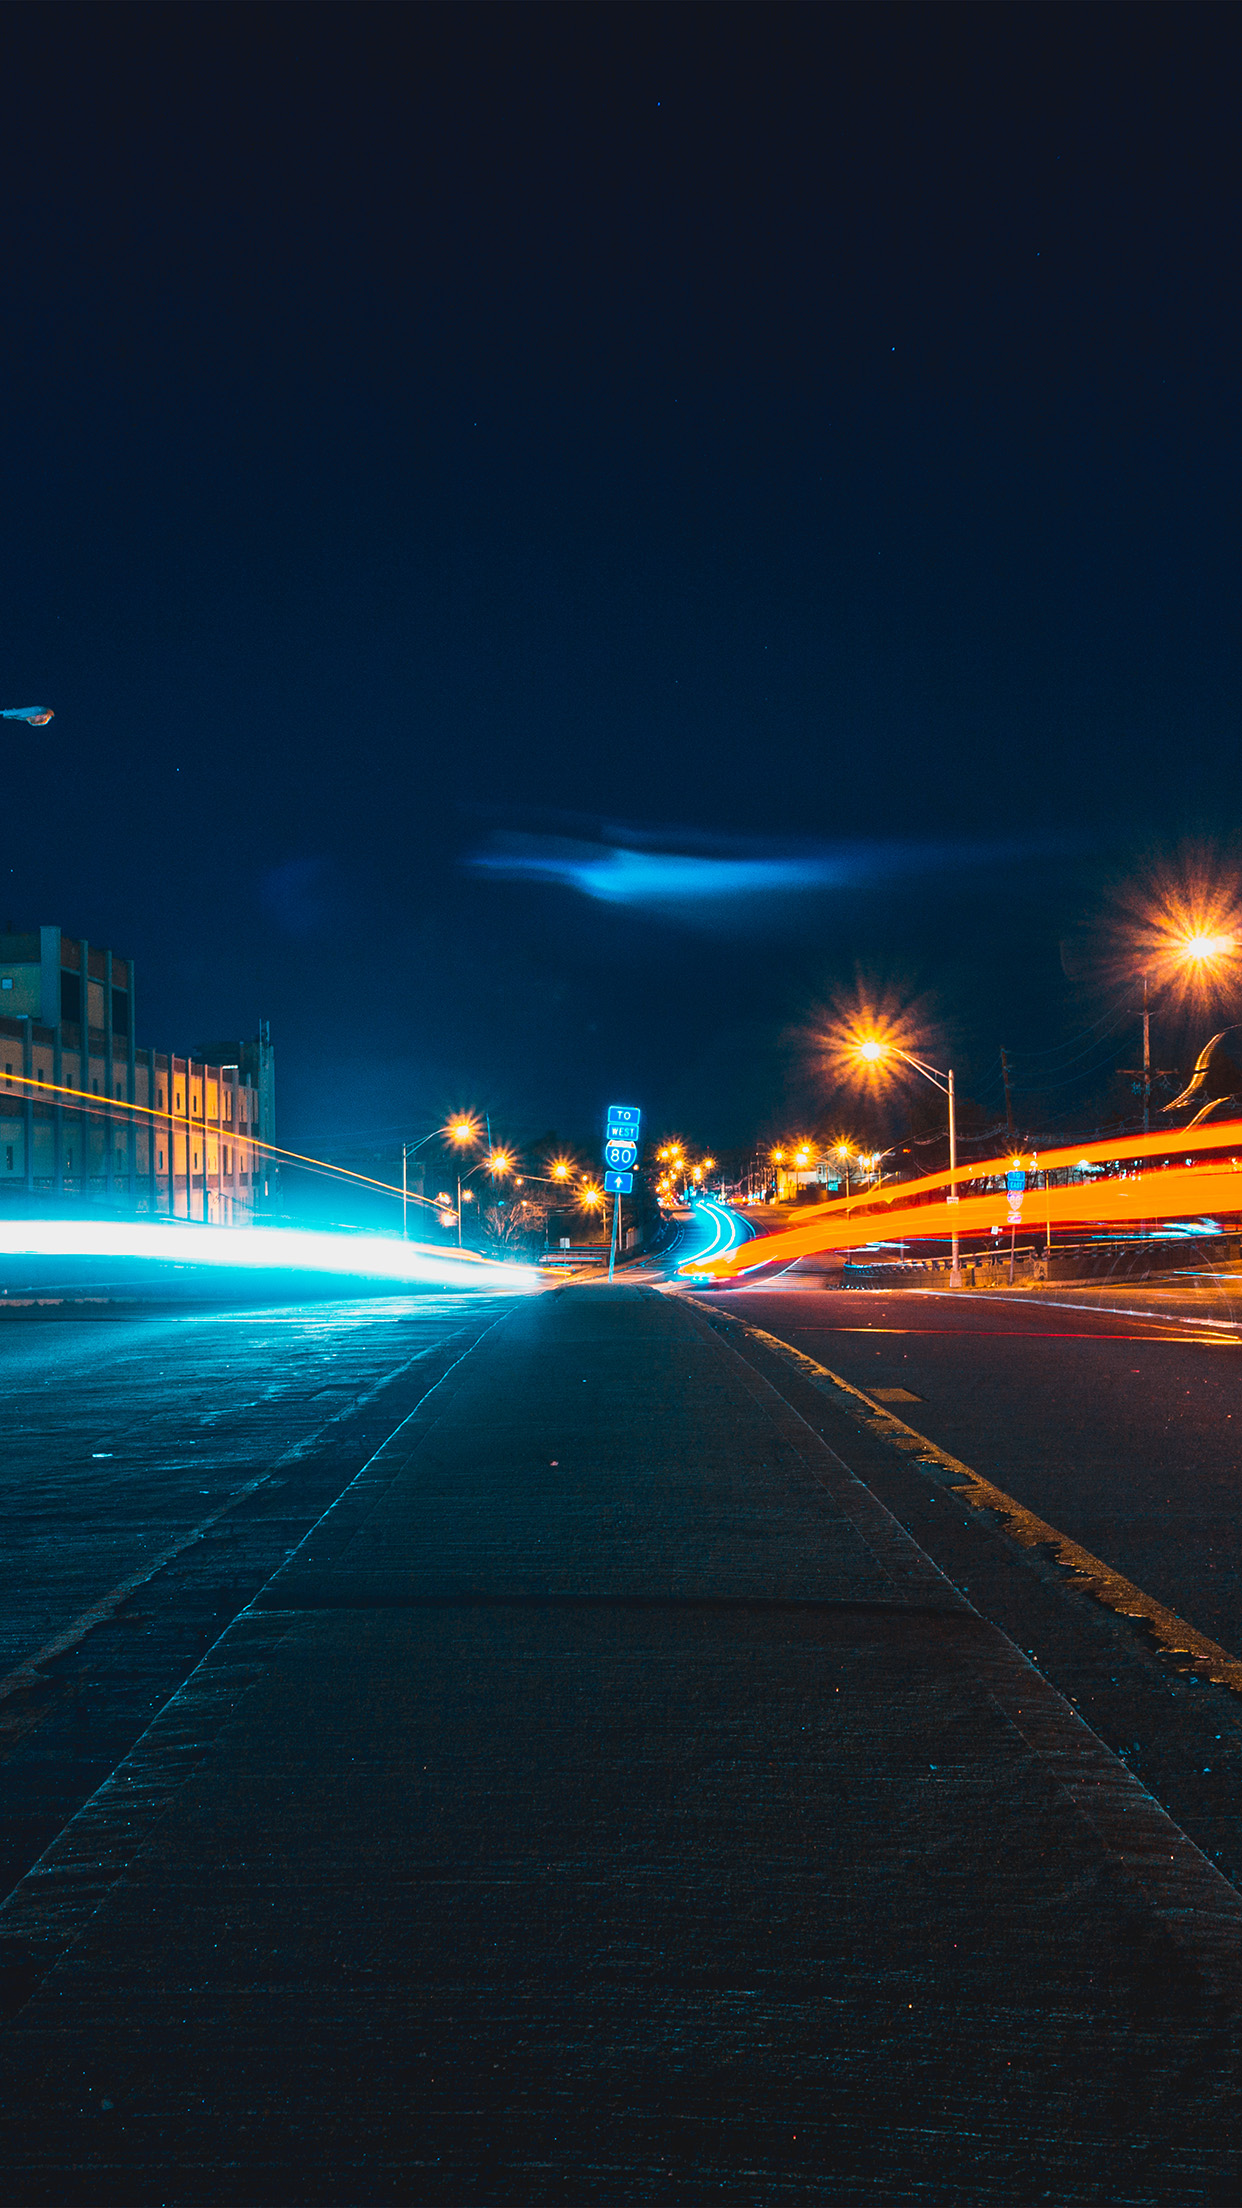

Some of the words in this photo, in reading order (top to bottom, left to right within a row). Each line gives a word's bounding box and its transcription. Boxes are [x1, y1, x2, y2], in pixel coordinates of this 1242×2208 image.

[617, 1110, 631, 1120] TO
[611, 1127, 635, 1138] WEST
[610, 1148, 631, 1163] 80
[1010, 1181, 1022, 1189] EAST
